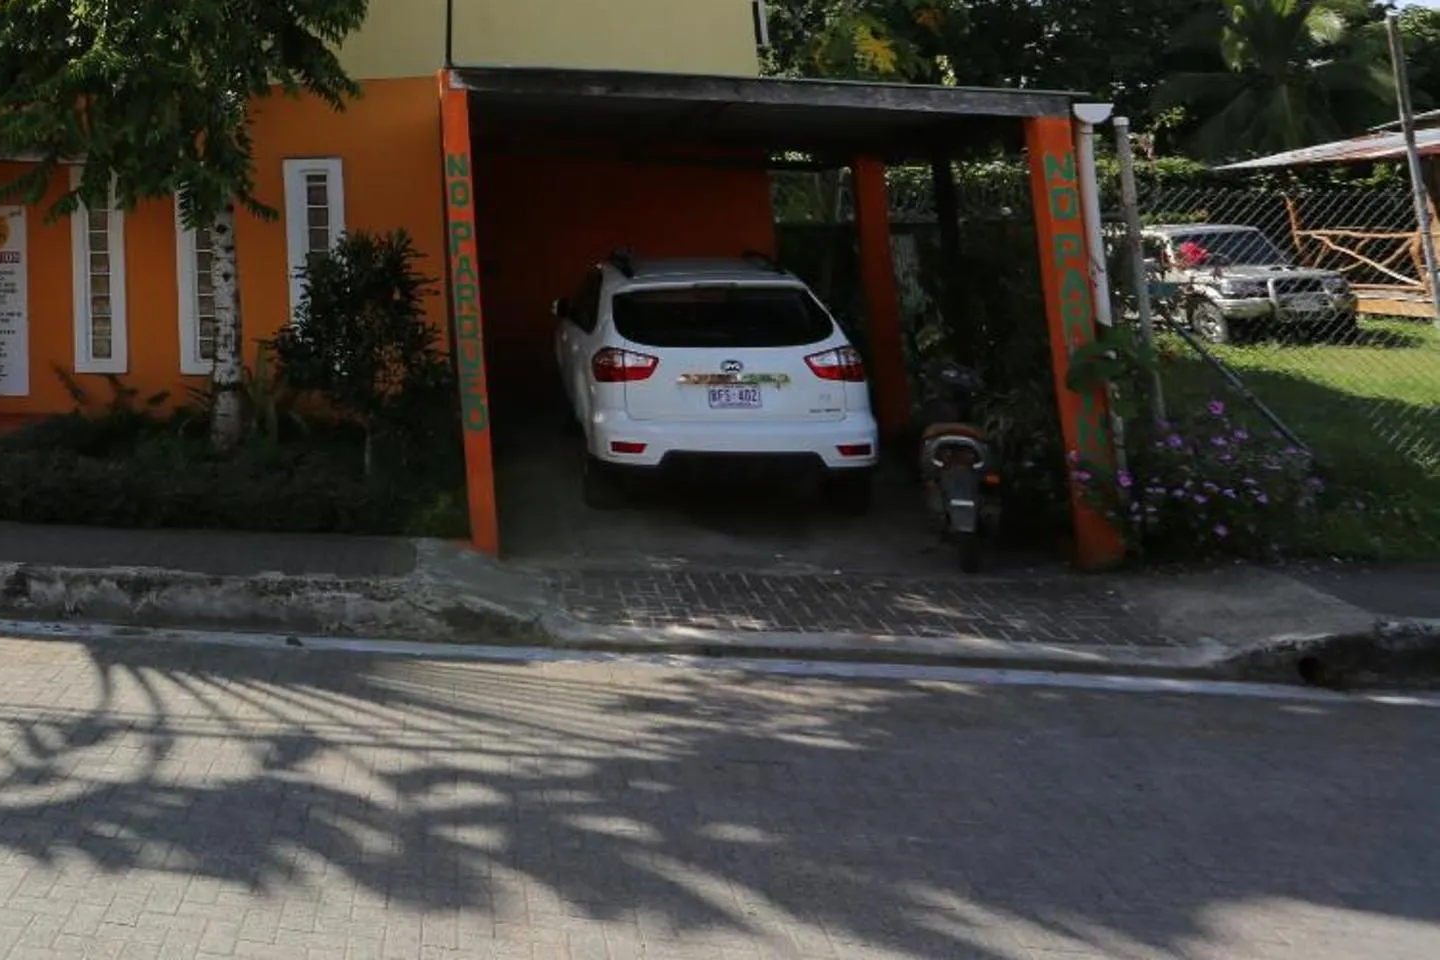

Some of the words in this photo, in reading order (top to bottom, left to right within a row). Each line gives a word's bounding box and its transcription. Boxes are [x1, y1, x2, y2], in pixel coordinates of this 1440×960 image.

[447, 152, 470, 208] NO
[1043, 153, 1078, 221] NO
[1054, 234, 1111, 456] PARIN
